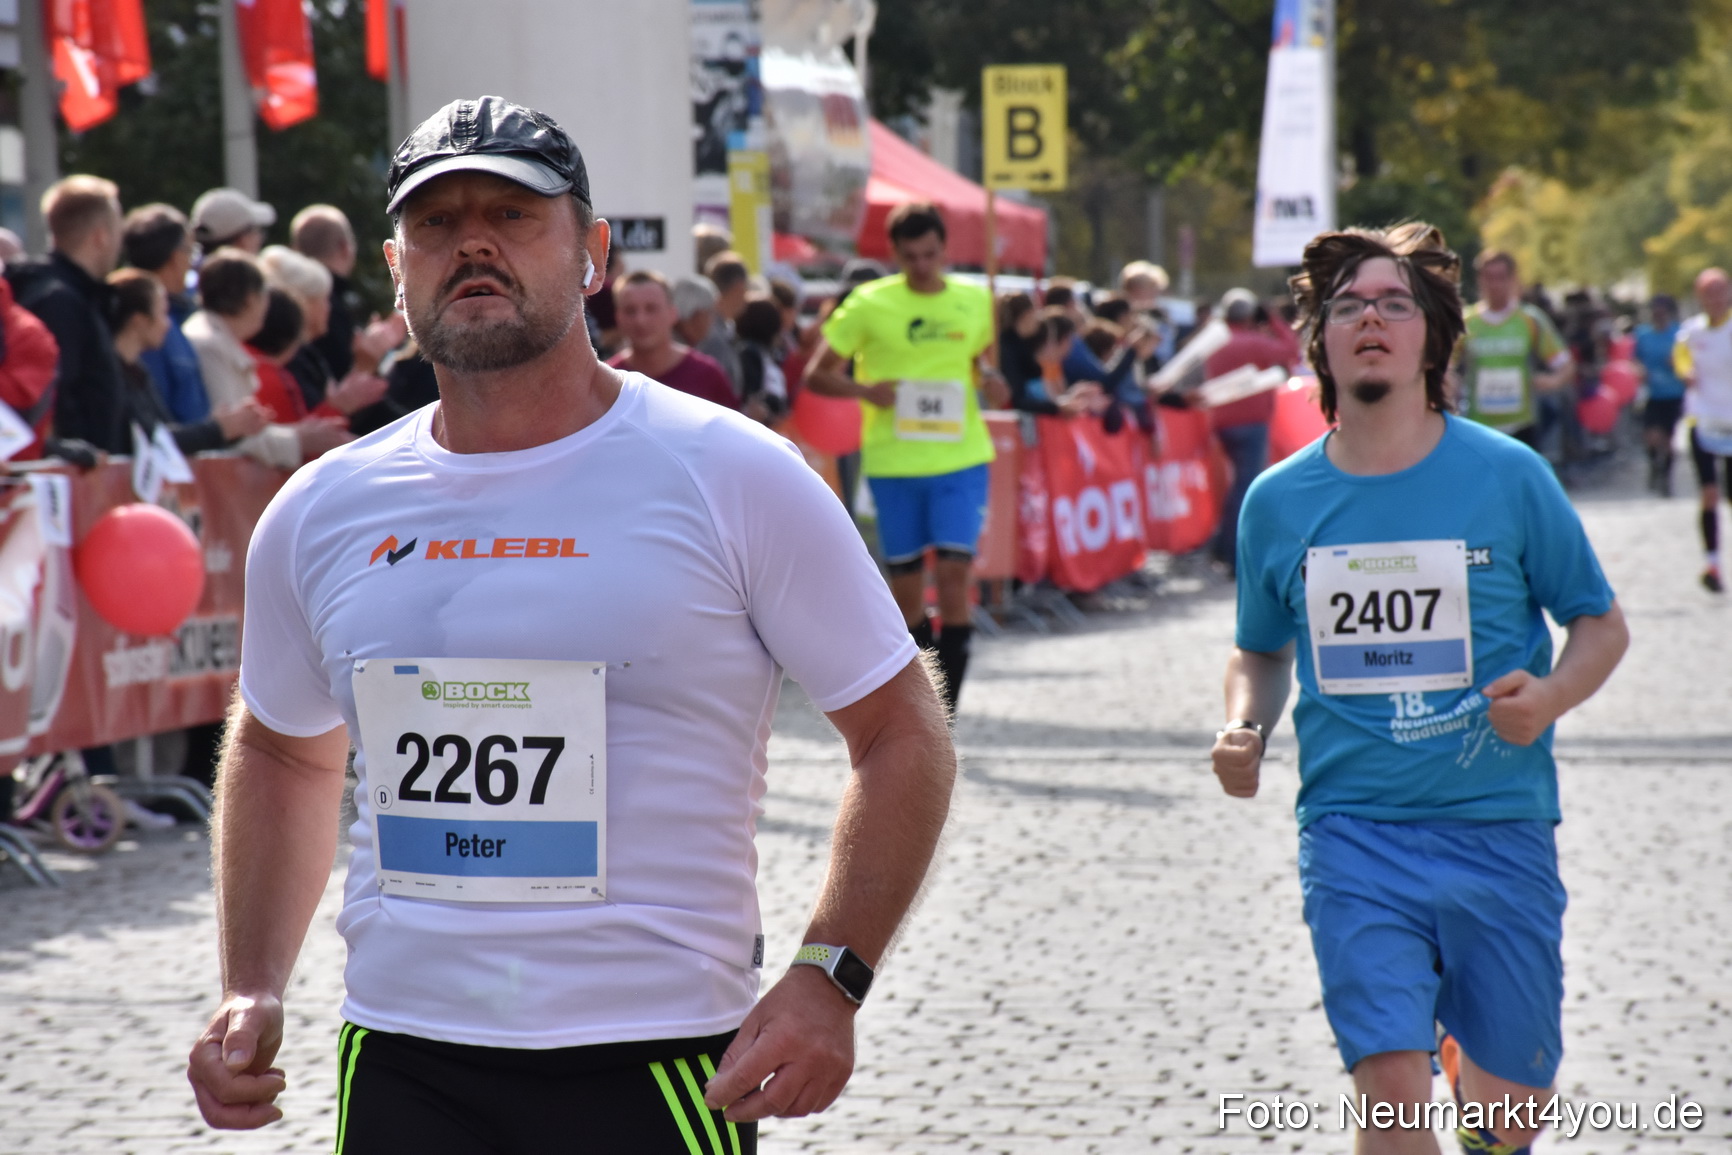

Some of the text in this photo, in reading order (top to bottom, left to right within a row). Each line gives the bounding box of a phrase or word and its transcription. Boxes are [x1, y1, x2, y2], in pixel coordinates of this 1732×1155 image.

[1007, 106, 1044, 160] B
[424, 538, 590, 560] KLEBL
[1363, 556, 1418, 571] BOCK
[1330, 588, 1442, 635] 2407
[1364, 649, 1414, 668] Moritz
[443, 681, 531, 702] BOCK
[443, 702, 470, 710] inspired
[470, 702, 480, 710] by
[502, 702, 533, 710] concepts
[1389, 691, 1436, 719] 18.
[1392, 714, 1471, 744] Stadtlauf
[396, 732, 566, 806] 2267
[379, 791, 388, 805] D
[445, 831, 507, 859] Peter
